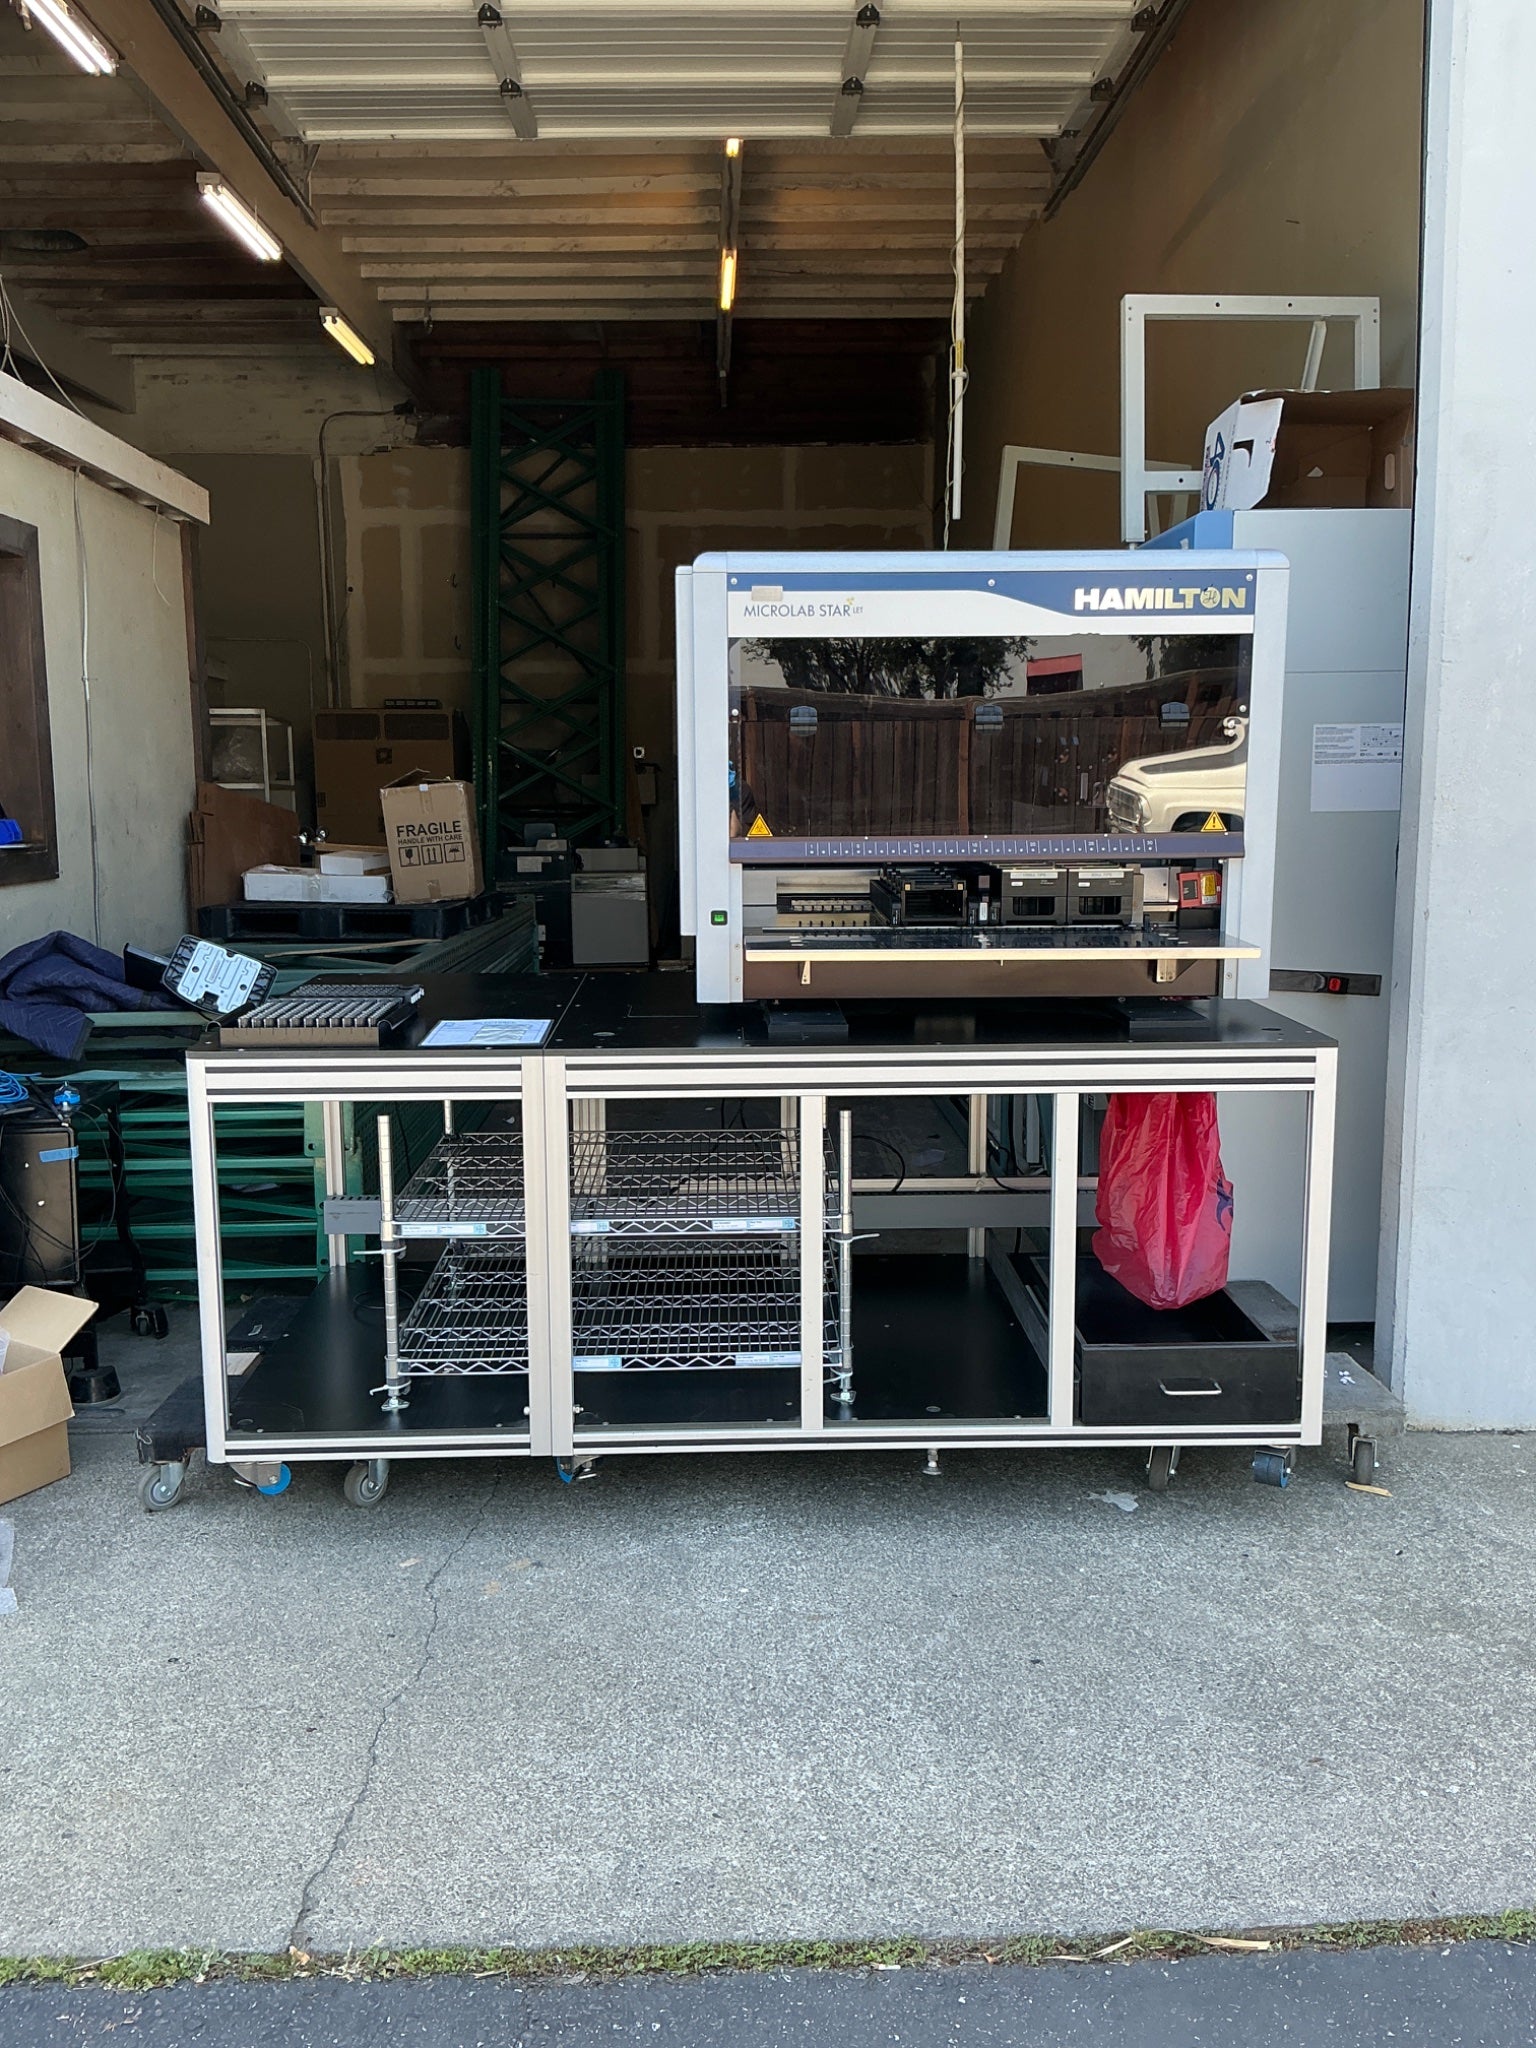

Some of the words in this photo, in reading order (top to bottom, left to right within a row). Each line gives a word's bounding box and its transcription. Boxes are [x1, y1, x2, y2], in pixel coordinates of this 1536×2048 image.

[1074, 587, 1246, 611] HAMILTON
[743, 604, 815, 617] MICROLAB
[396, 820, 462, 838] FRAGILE
[397, 836, 425, 846] HANDLE
[426, 835, 443, 843] WITH
[444, 834, 463, 842] CARE
